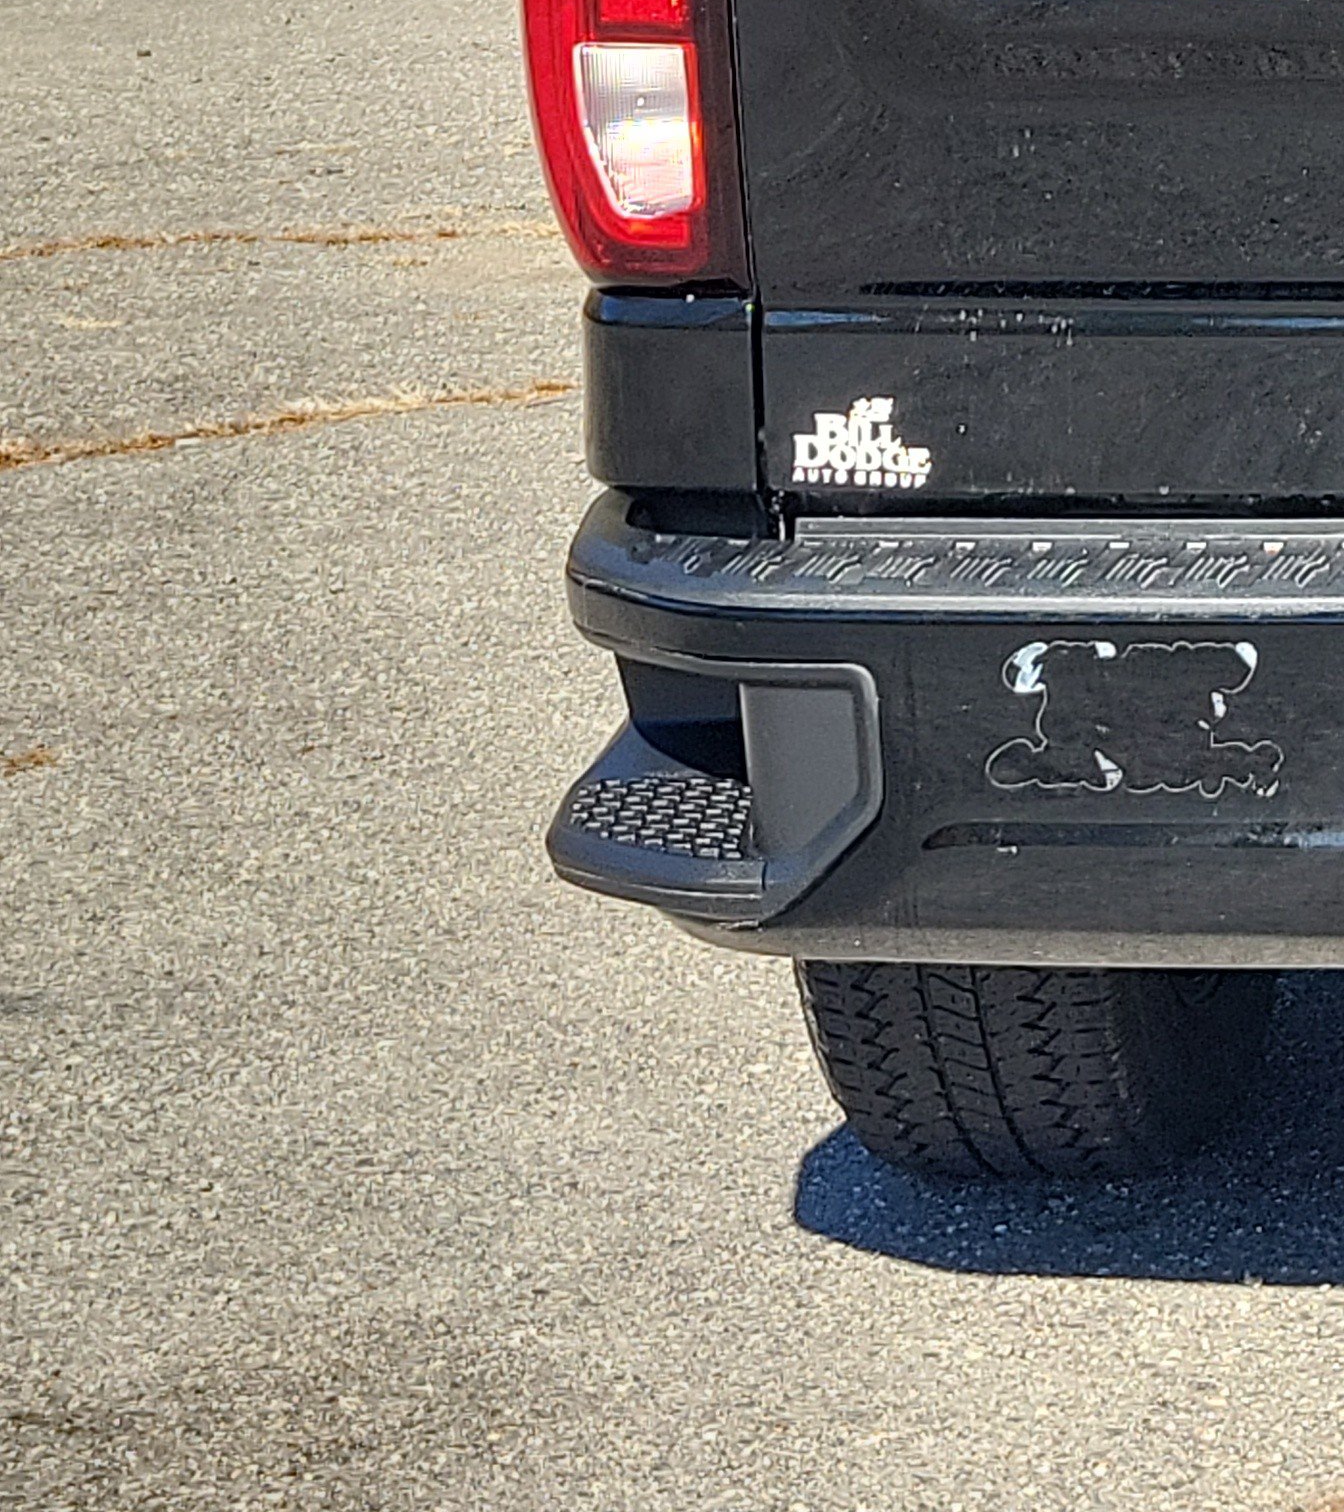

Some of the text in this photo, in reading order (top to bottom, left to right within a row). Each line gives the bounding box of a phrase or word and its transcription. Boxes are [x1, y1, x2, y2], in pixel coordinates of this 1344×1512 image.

[814, 410, 902, 450] BILL
[793, 434, 932, 473] DODGE
[792, 466, 848, 484] AUTO
